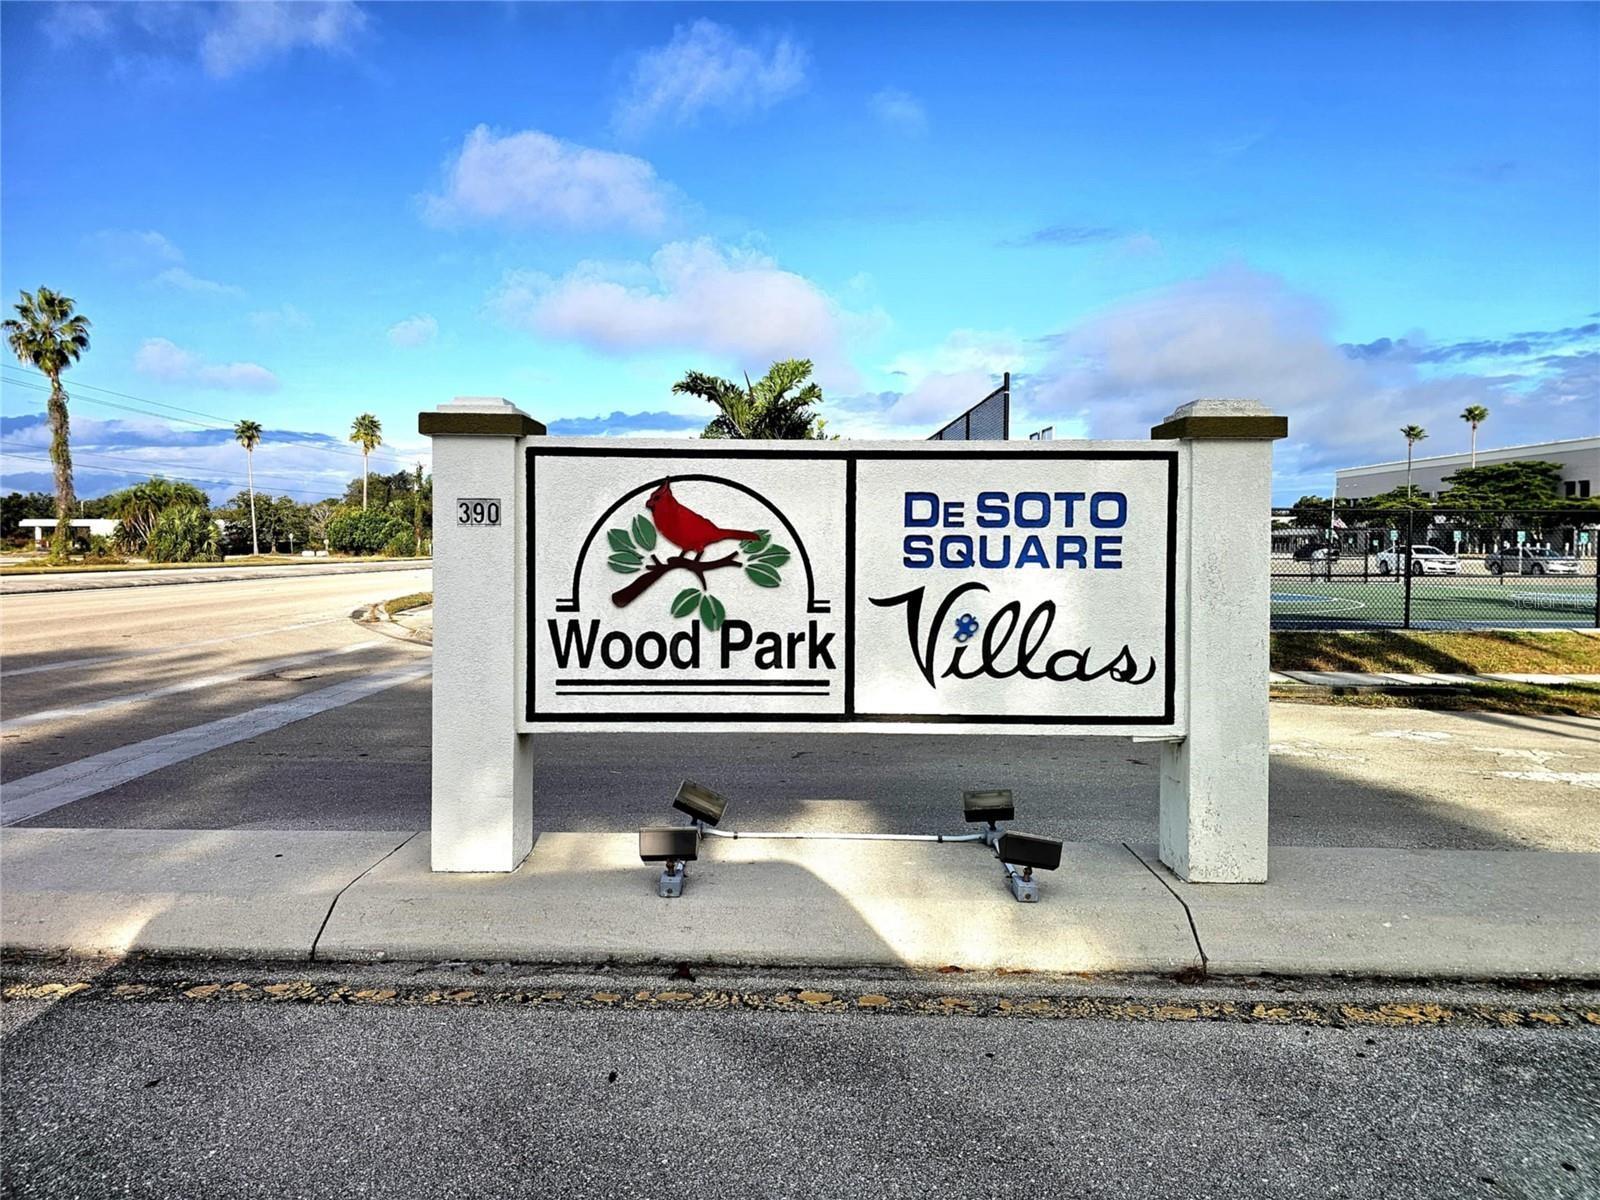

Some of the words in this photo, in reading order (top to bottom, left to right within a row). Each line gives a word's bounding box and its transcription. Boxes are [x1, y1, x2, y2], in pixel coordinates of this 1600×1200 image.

[458, 502, 500, 524] 390
[976, 491, 1128, 529] SOTO
[903, 535, 1123, 569] SQUARE
[547, 619, 700, 670] Wood
[720, 619, 836, 670] Park
[868, 581, 1157, 689] Villas
